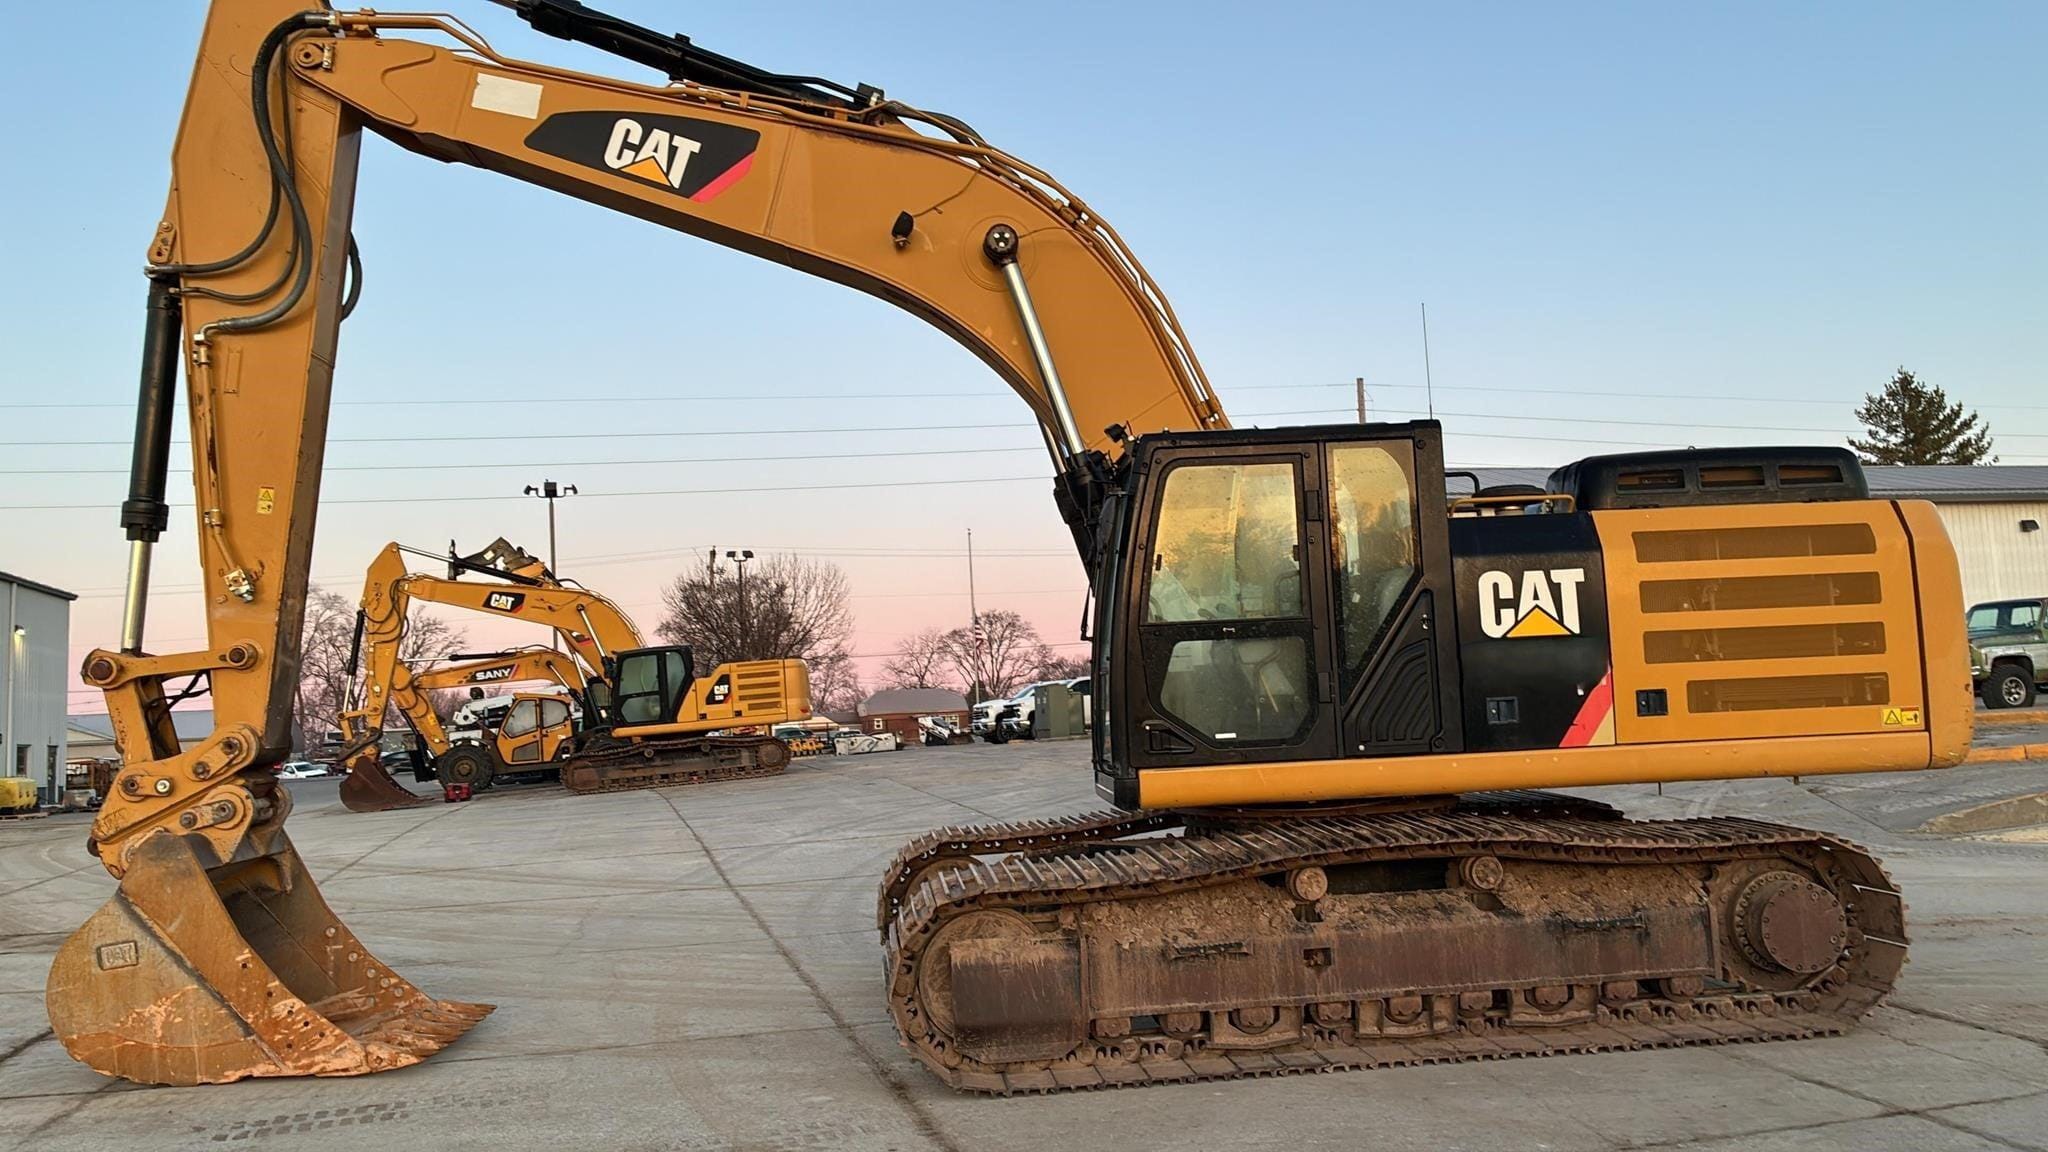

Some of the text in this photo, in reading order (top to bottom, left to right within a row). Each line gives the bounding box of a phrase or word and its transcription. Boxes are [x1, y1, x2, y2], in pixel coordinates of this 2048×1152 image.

[604, 118, 702, 189] CAT
[490, 593, 515, 610] CAT
[1478, 568, 1585, 639] CAT
[475, 668, 511, 680] SANY
